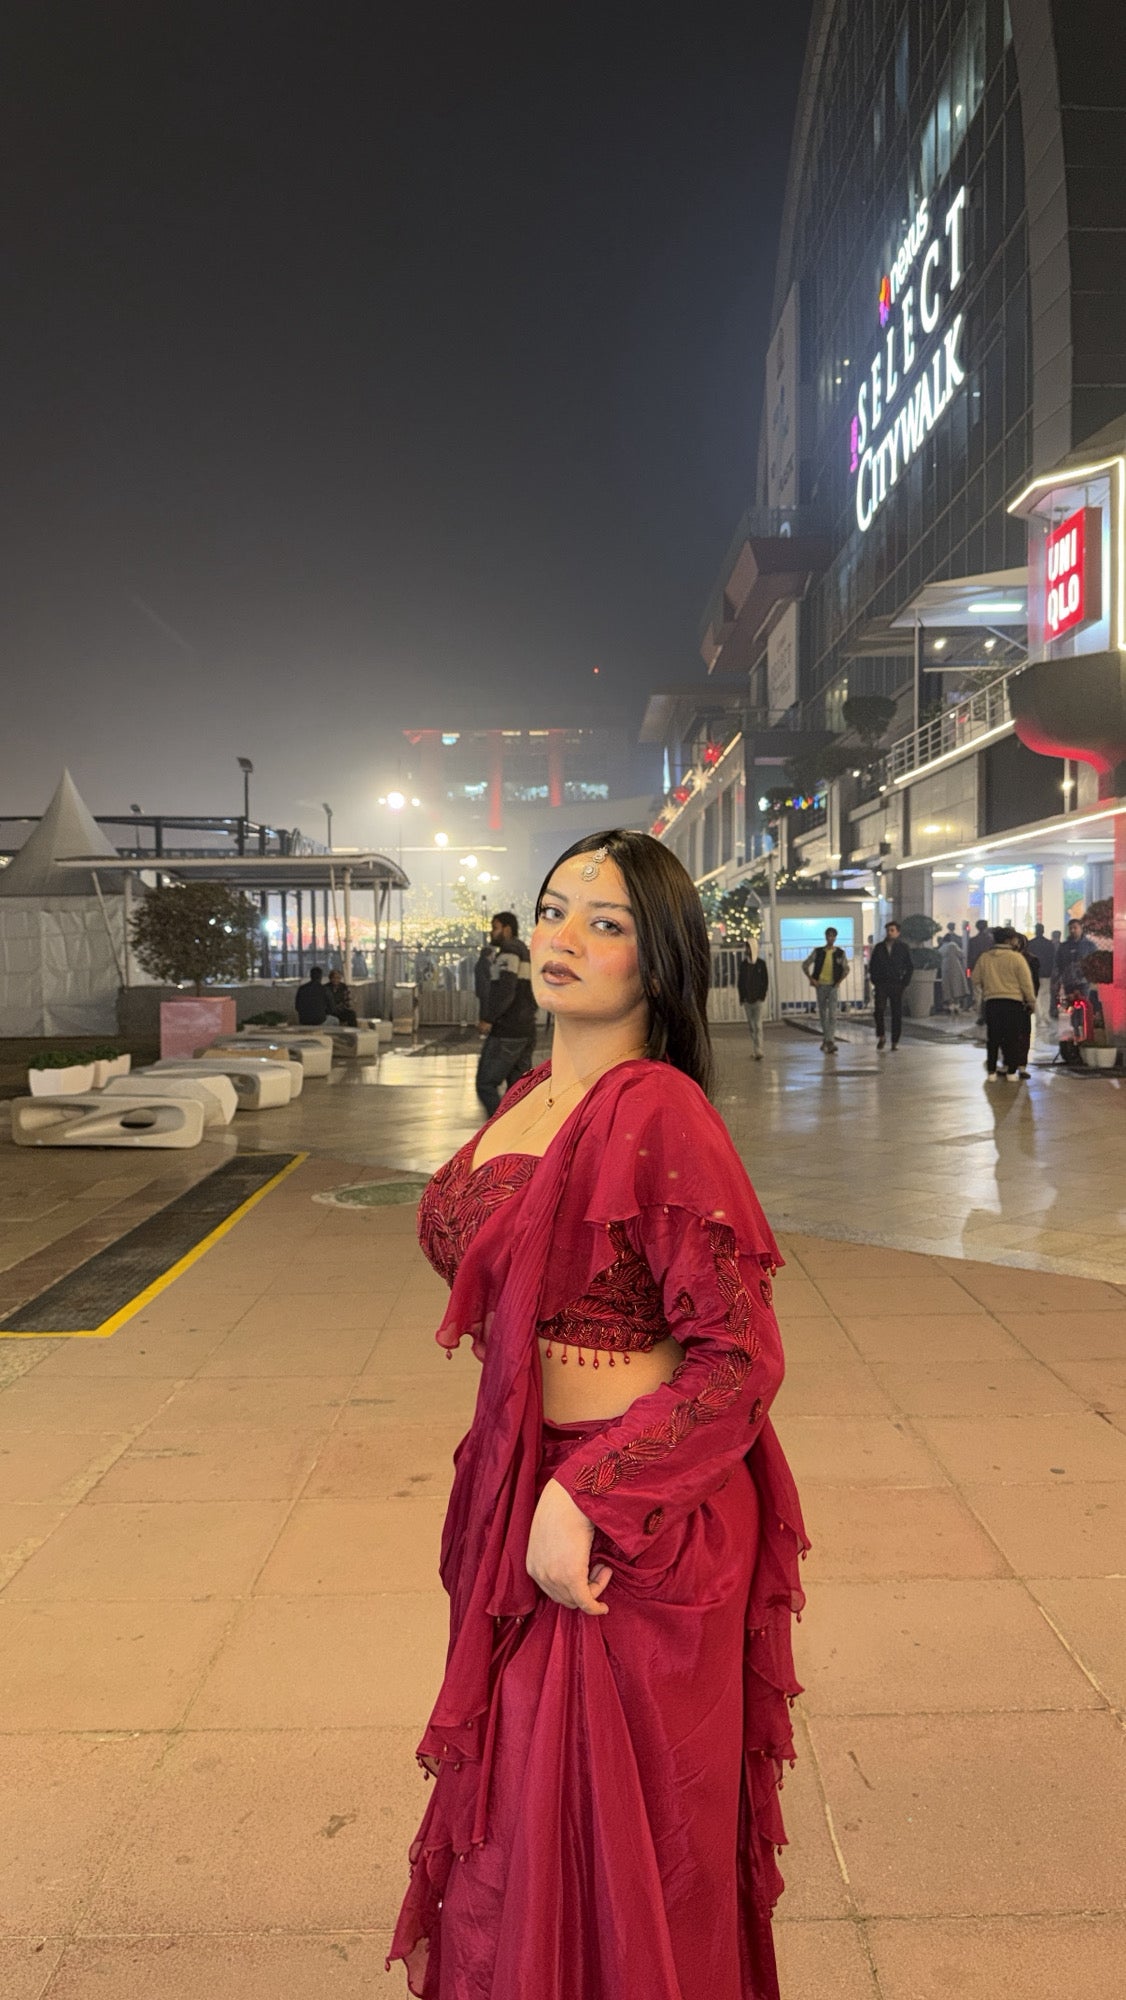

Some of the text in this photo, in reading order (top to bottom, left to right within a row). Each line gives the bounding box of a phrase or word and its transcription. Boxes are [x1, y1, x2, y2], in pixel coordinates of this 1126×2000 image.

[890, 197, 928, 304] nexus
[858, 186, 965, 454] SELECT
[856, 313, 964, 532] CITYWALK
[1048, 528, 1077, 582] UNI
[1048, 573, 1080, 631] QLO
